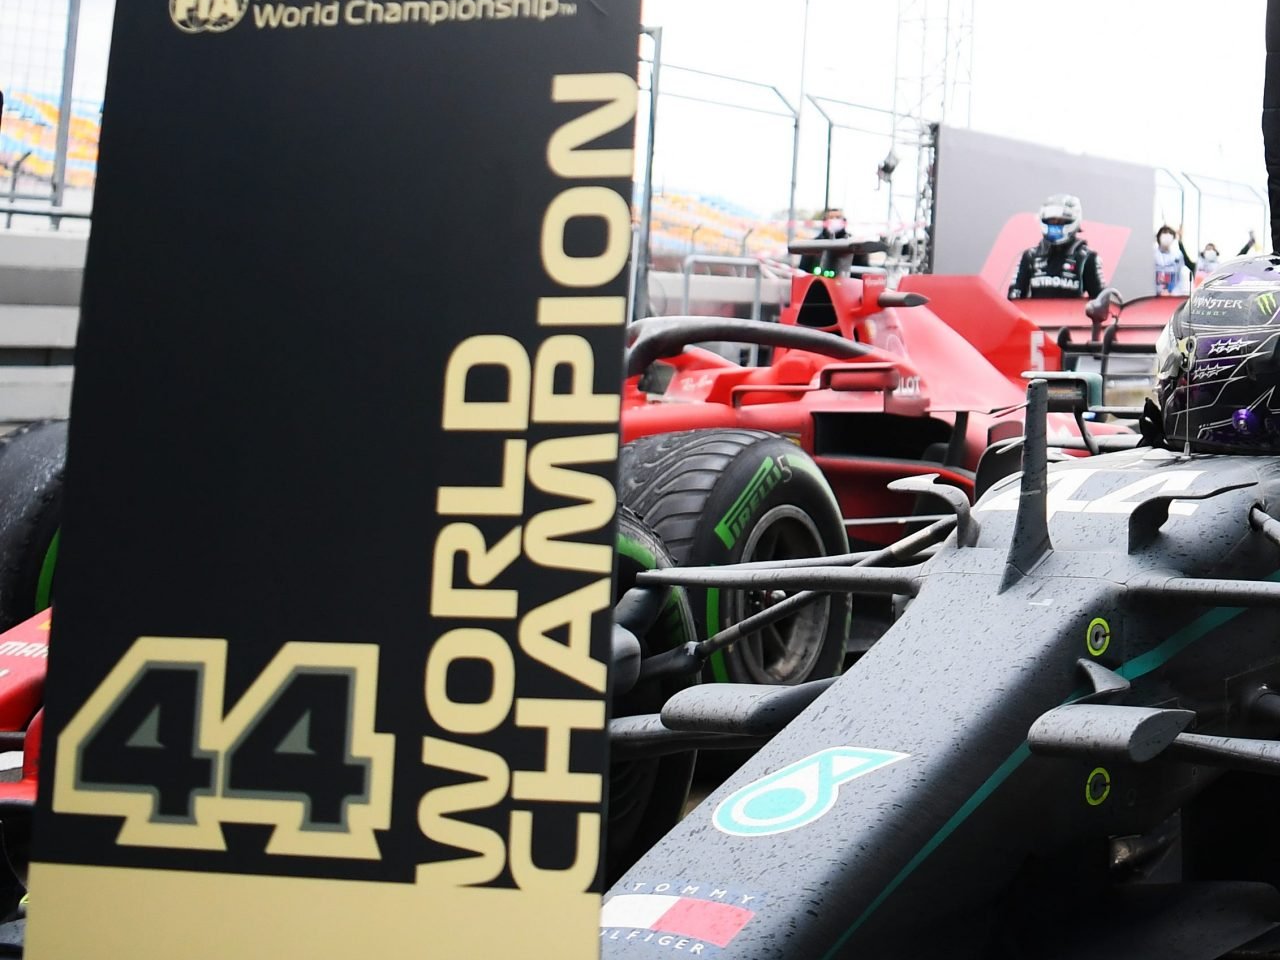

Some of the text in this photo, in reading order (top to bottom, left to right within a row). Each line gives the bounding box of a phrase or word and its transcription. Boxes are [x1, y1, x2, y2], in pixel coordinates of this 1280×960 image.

[254, 1, 341, 29] World
[1193, 296, 1243, 309] MONSTER
[508, 72, 640, 893] CHAMPION
[415, 334, 532, 887] WORLD
[53, 636, 395, 859] 44
[633, 882, 754, 905] TOMMY
[599, 929, 705, 955] ILFIGER
